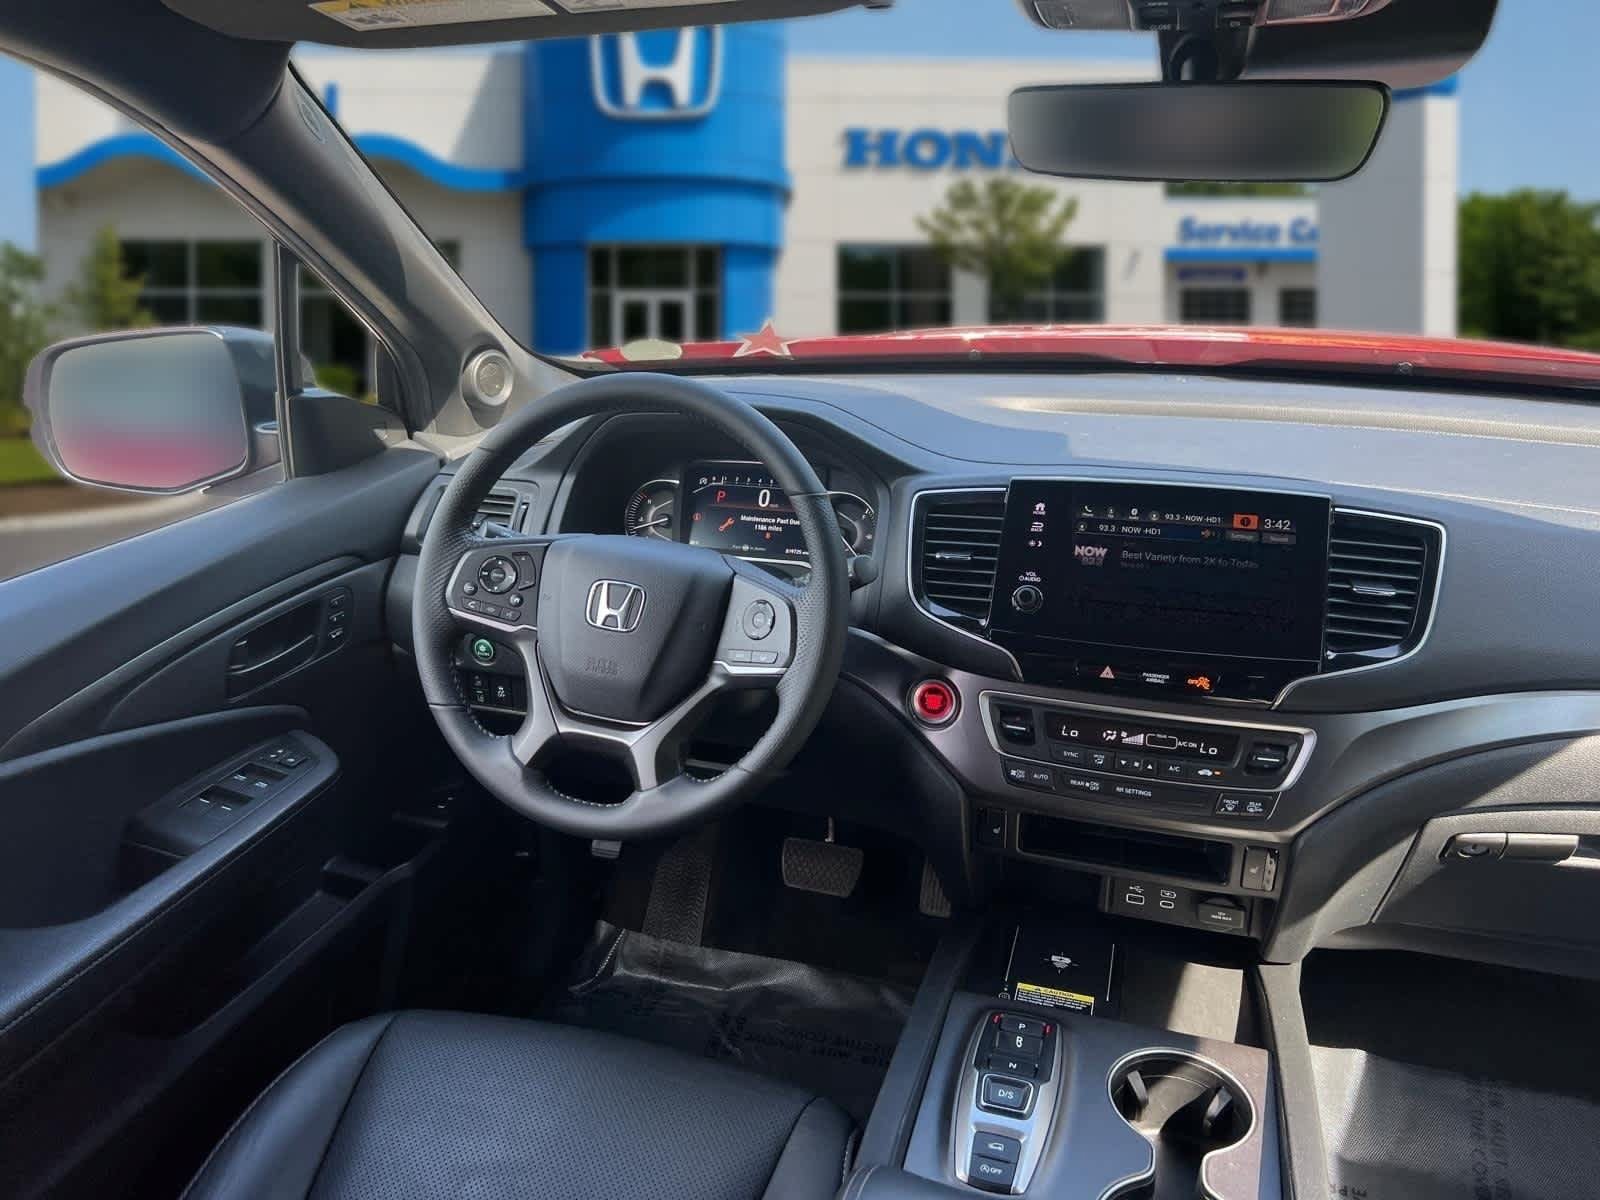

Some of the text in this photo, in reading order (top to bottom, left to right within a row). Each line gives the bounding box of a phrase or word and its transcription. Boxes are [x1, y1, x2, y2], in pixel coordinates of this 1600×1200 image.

[844, 126, 1018, 173] HON
[1179, 216, 1282, 242] Service
[716, 489, 771, 508] P 0
[740, 514, 776, 523] Maintenance
[776, 517, 789, 525] Past
[1164, 513, 1181, 521] 93.3
[1185, 515, 1202, 523] NOW
[1098, 524, 1116, 533] 93.3
[1121, 526, 1141, 535] NOW
[1264, 518, 1291, 531] 3:42
[1074, 545, 1108, 558] NOW
[1122, 550, 1142, 559] Best
[1144, 551, 1178, 563] Variety
[1178, 553, 1201, 564] from
[1061, 725, 1079, 737] Lo
[1063, 750, 1079, 758] SYNC
[1200, 742, 1218, 755] Lo
[1168, 765, 1181, 773] A/C
[1033, 772, 1049, 780] AUTO
[1125, 788, 1152, 797] SETTINGS
[998, 1089, 1014, 1100] D/S
[990, 1167, 1003, 1176] OFF
